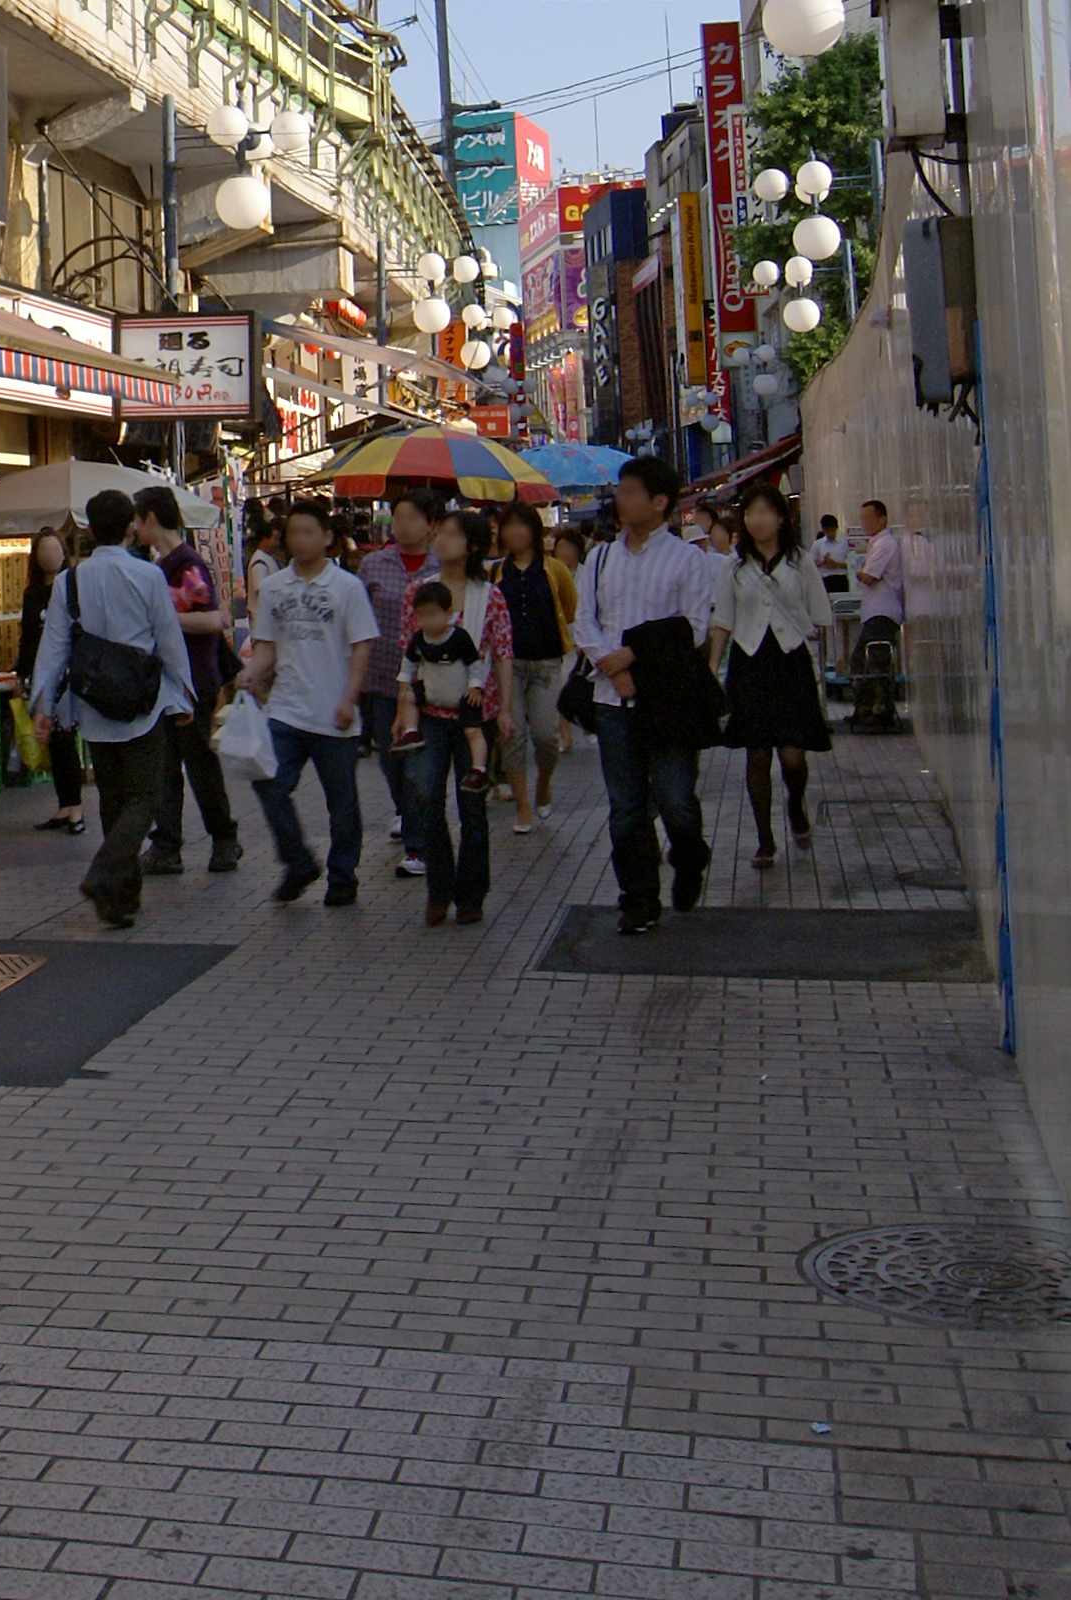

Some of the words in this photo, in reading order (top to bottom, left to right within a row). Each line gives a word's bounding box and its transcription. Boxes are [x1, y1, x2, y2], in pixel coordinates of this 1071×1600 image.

[709, 41, 736, 162] カラオケ
[592, 296, 609, 387] GAME
